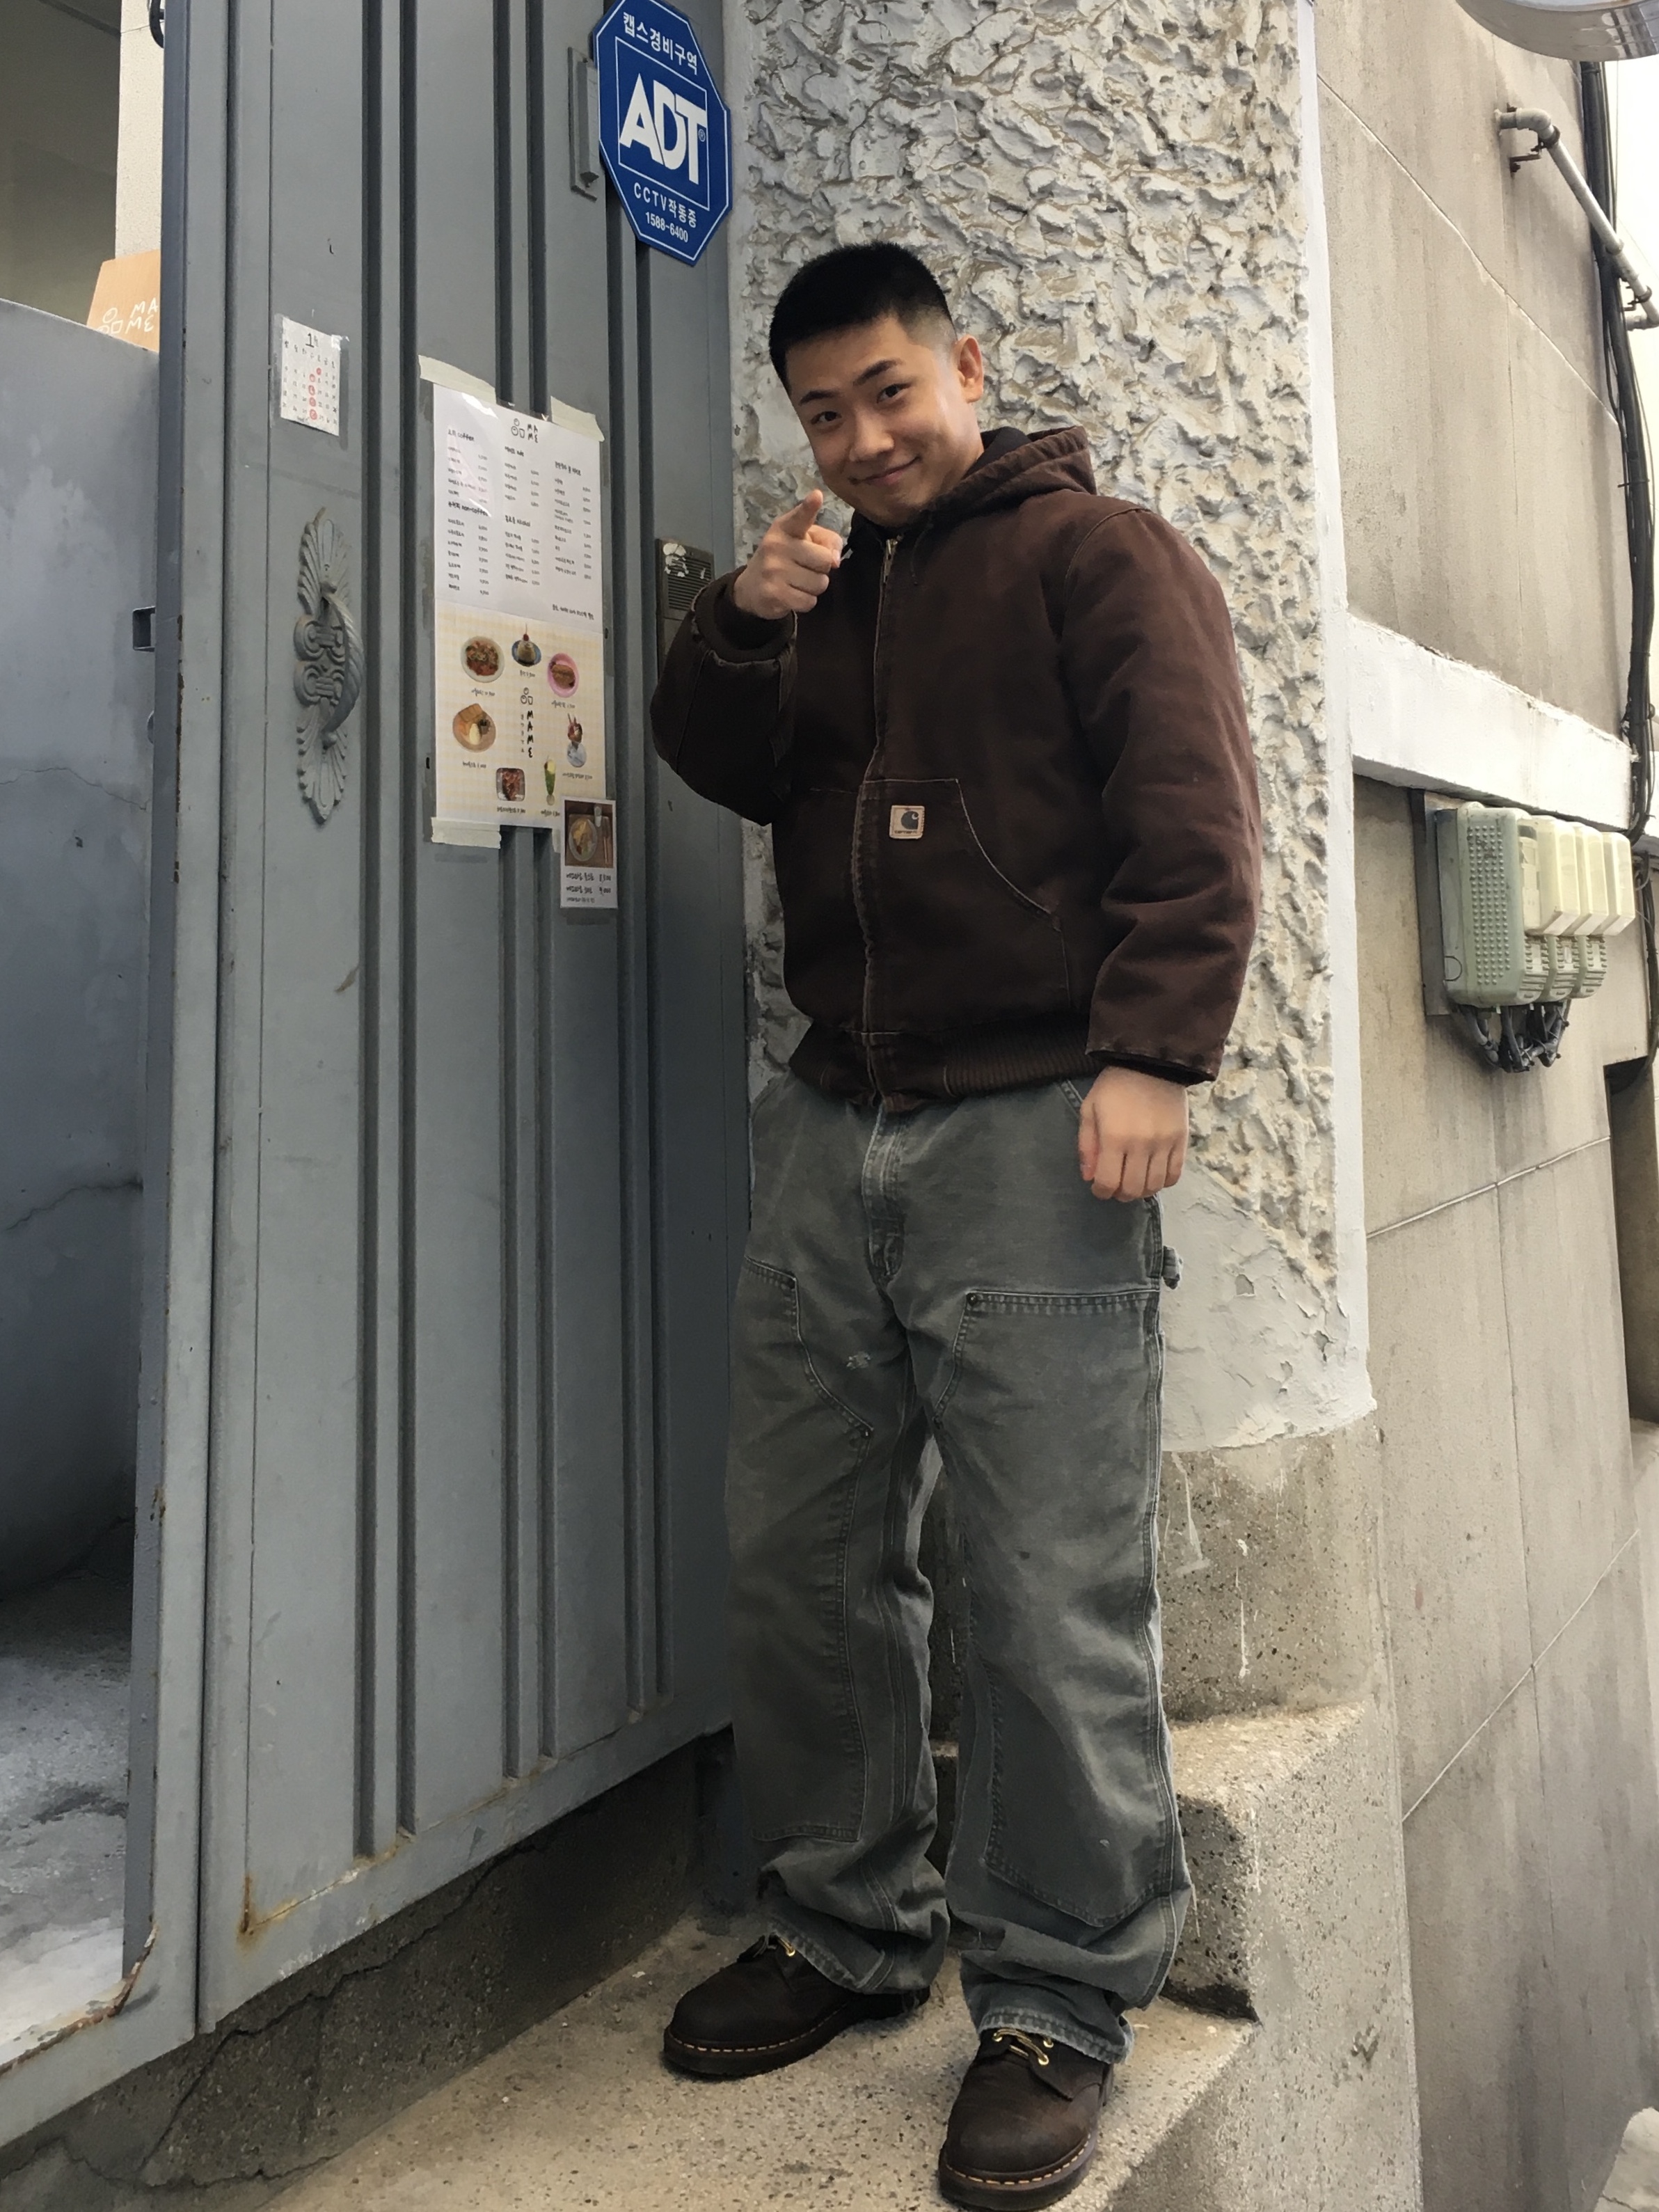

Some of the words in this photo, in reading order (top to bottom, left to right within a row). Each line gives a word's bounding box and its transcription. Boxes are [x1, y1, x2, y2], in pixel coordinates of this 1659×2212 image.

[624, 12, 697, 75] 캡스경비구역
[619, 73, 708, 184] ADT
[645, 211, 689, 244] 1588-6400
